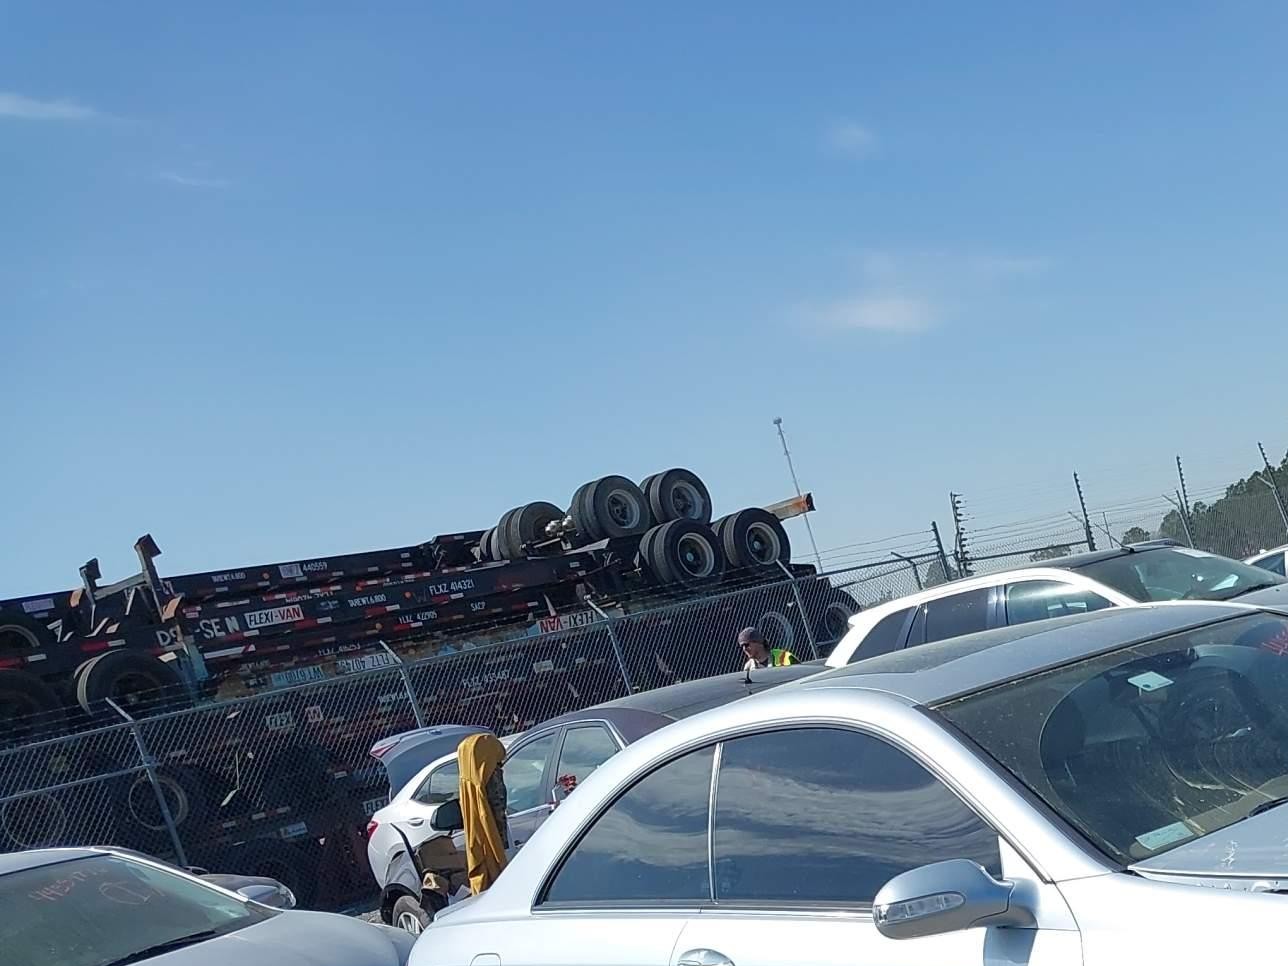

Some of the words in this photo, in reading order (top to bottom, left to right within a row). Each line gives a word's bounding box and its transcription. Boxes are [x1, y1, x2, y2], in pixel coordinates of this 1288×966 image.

[429, 582, 450, 596] FLXZ
[450, 579, 476, 592] 414321
[249, 607, 302, 626] FLEXI-VAN
[540, 610, 595, 633] FLEXI-VAN
